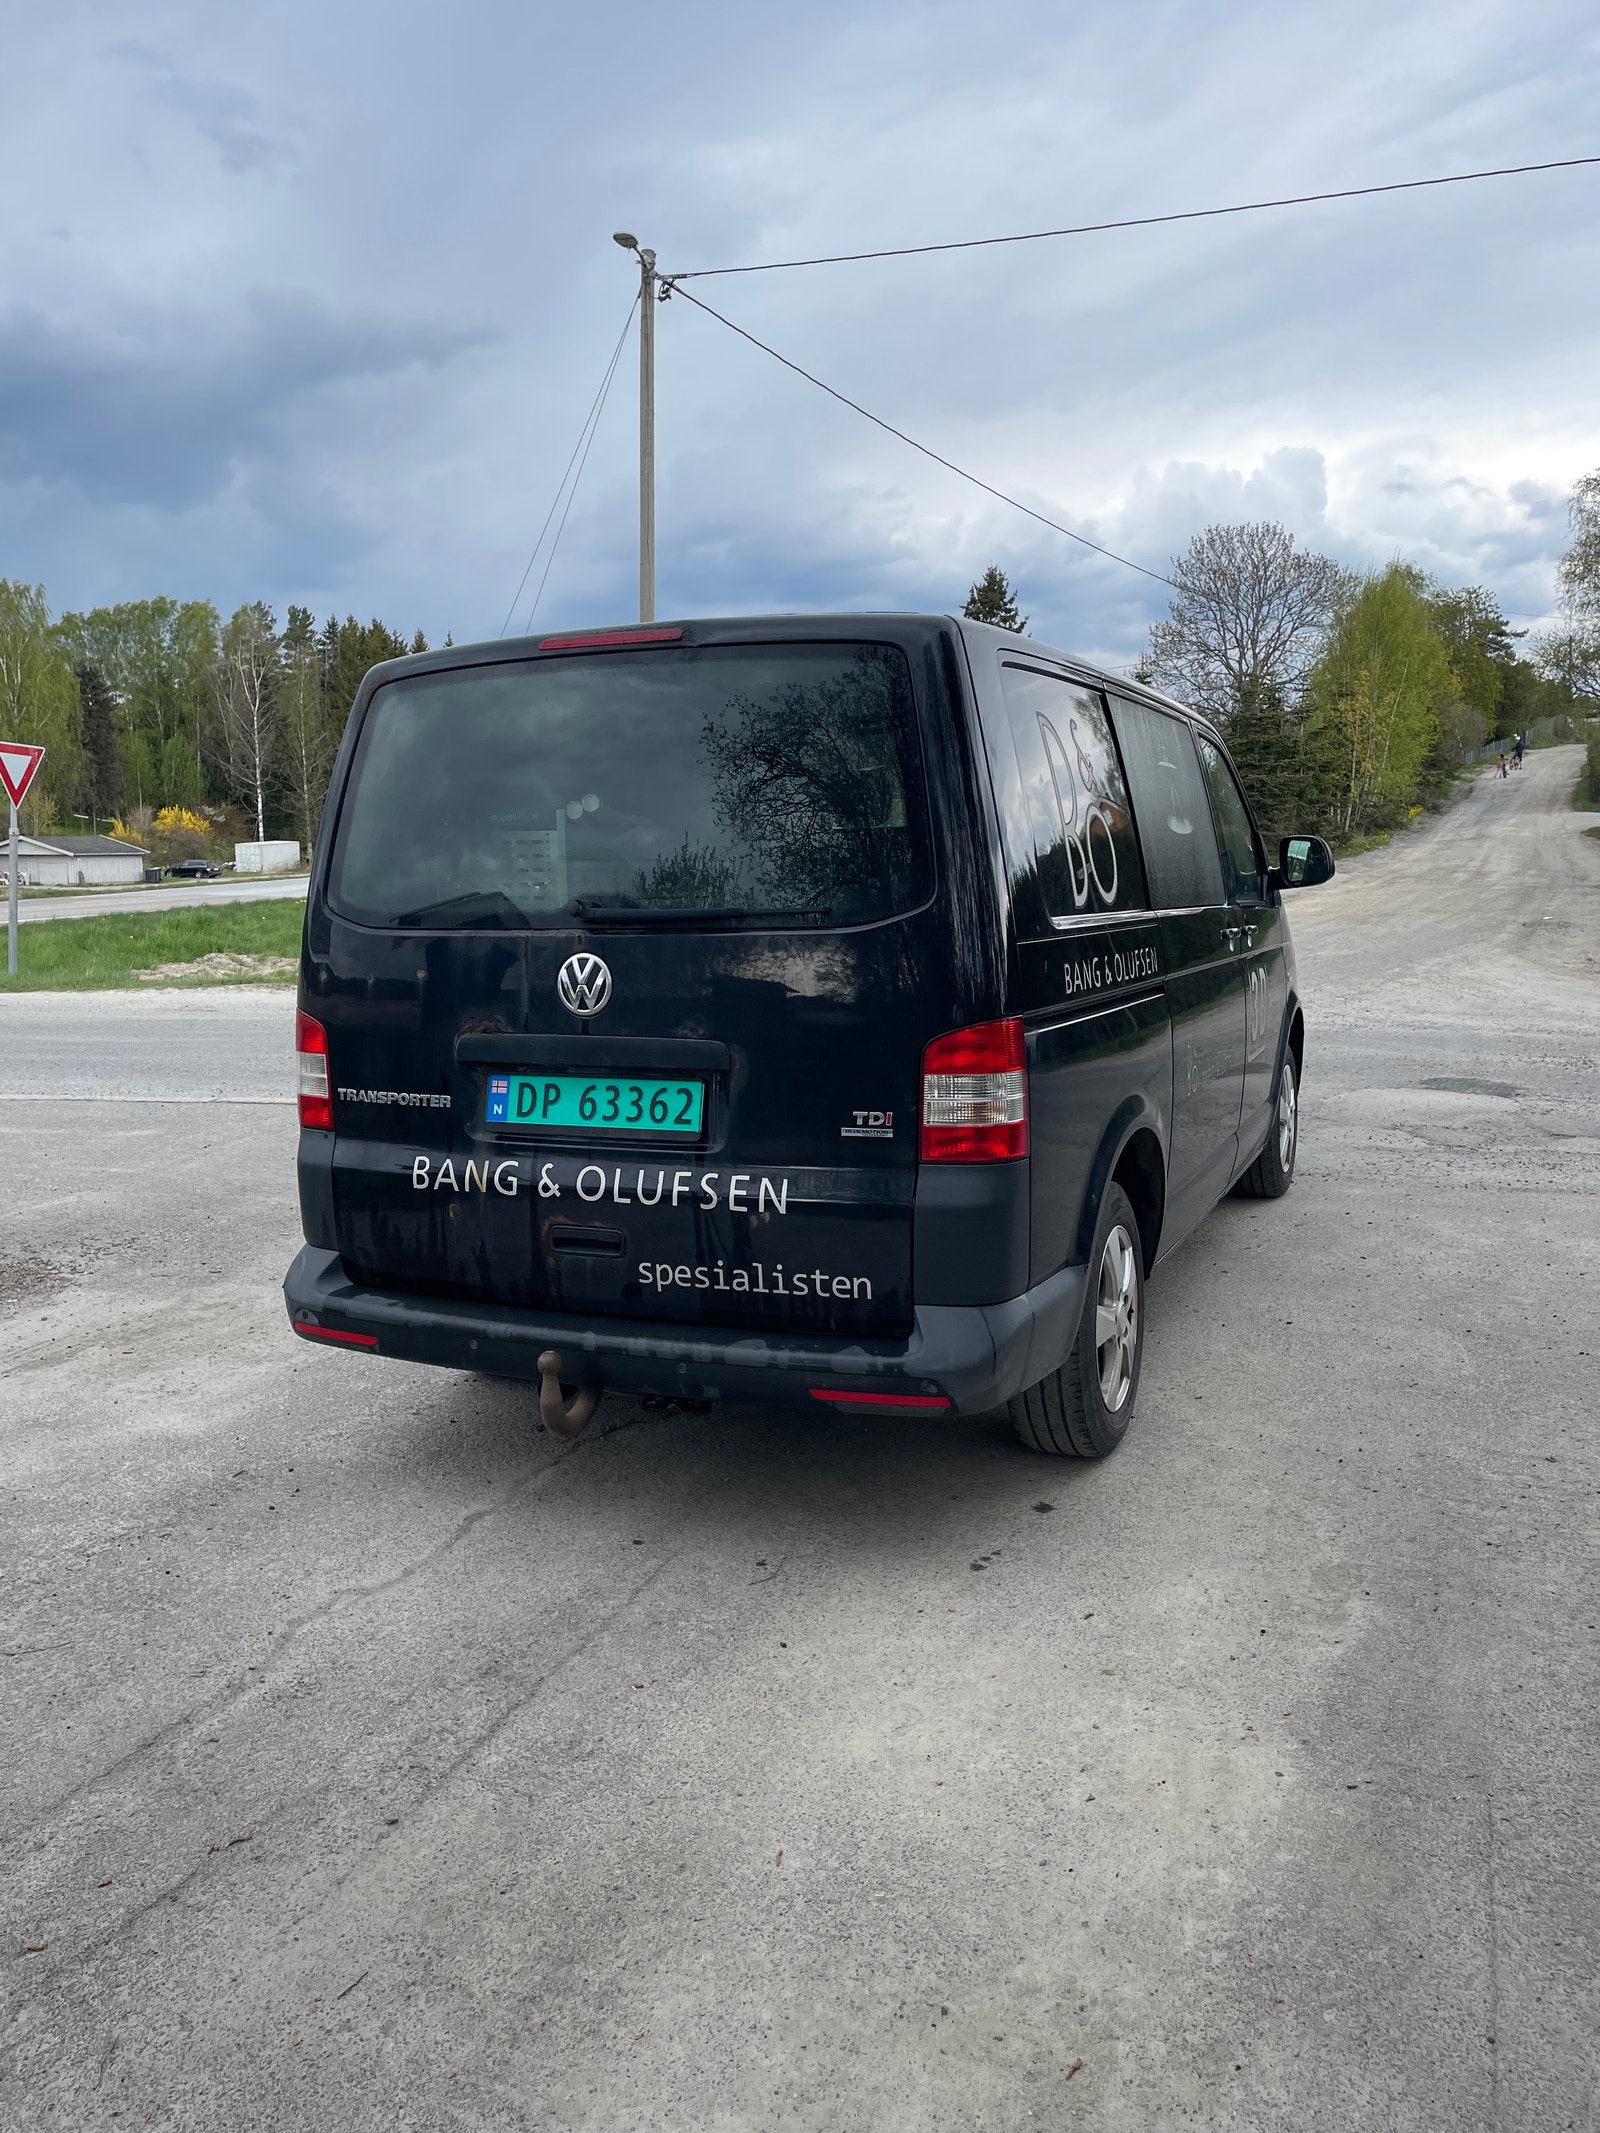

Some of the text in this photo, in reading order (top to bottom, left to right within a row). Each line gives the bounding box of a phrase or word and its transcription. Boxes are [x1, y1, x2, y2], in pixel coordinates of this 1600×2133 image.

[559, 954, 611, 1014] VW
[1064, 947, 1158, 994] BANG & OLUFSEN
[337, 1088, 451, 1108] TRANSPORTER
[493, 1104, 502, 1115] N
[516, 1082, 694, 1126] DP 63362
[853, 1111, 893, 1126] TDI
[412, 1156, 788, 1214] BANG & OLUFSEN
[638, 1259, 872, 1300] spesialisten
